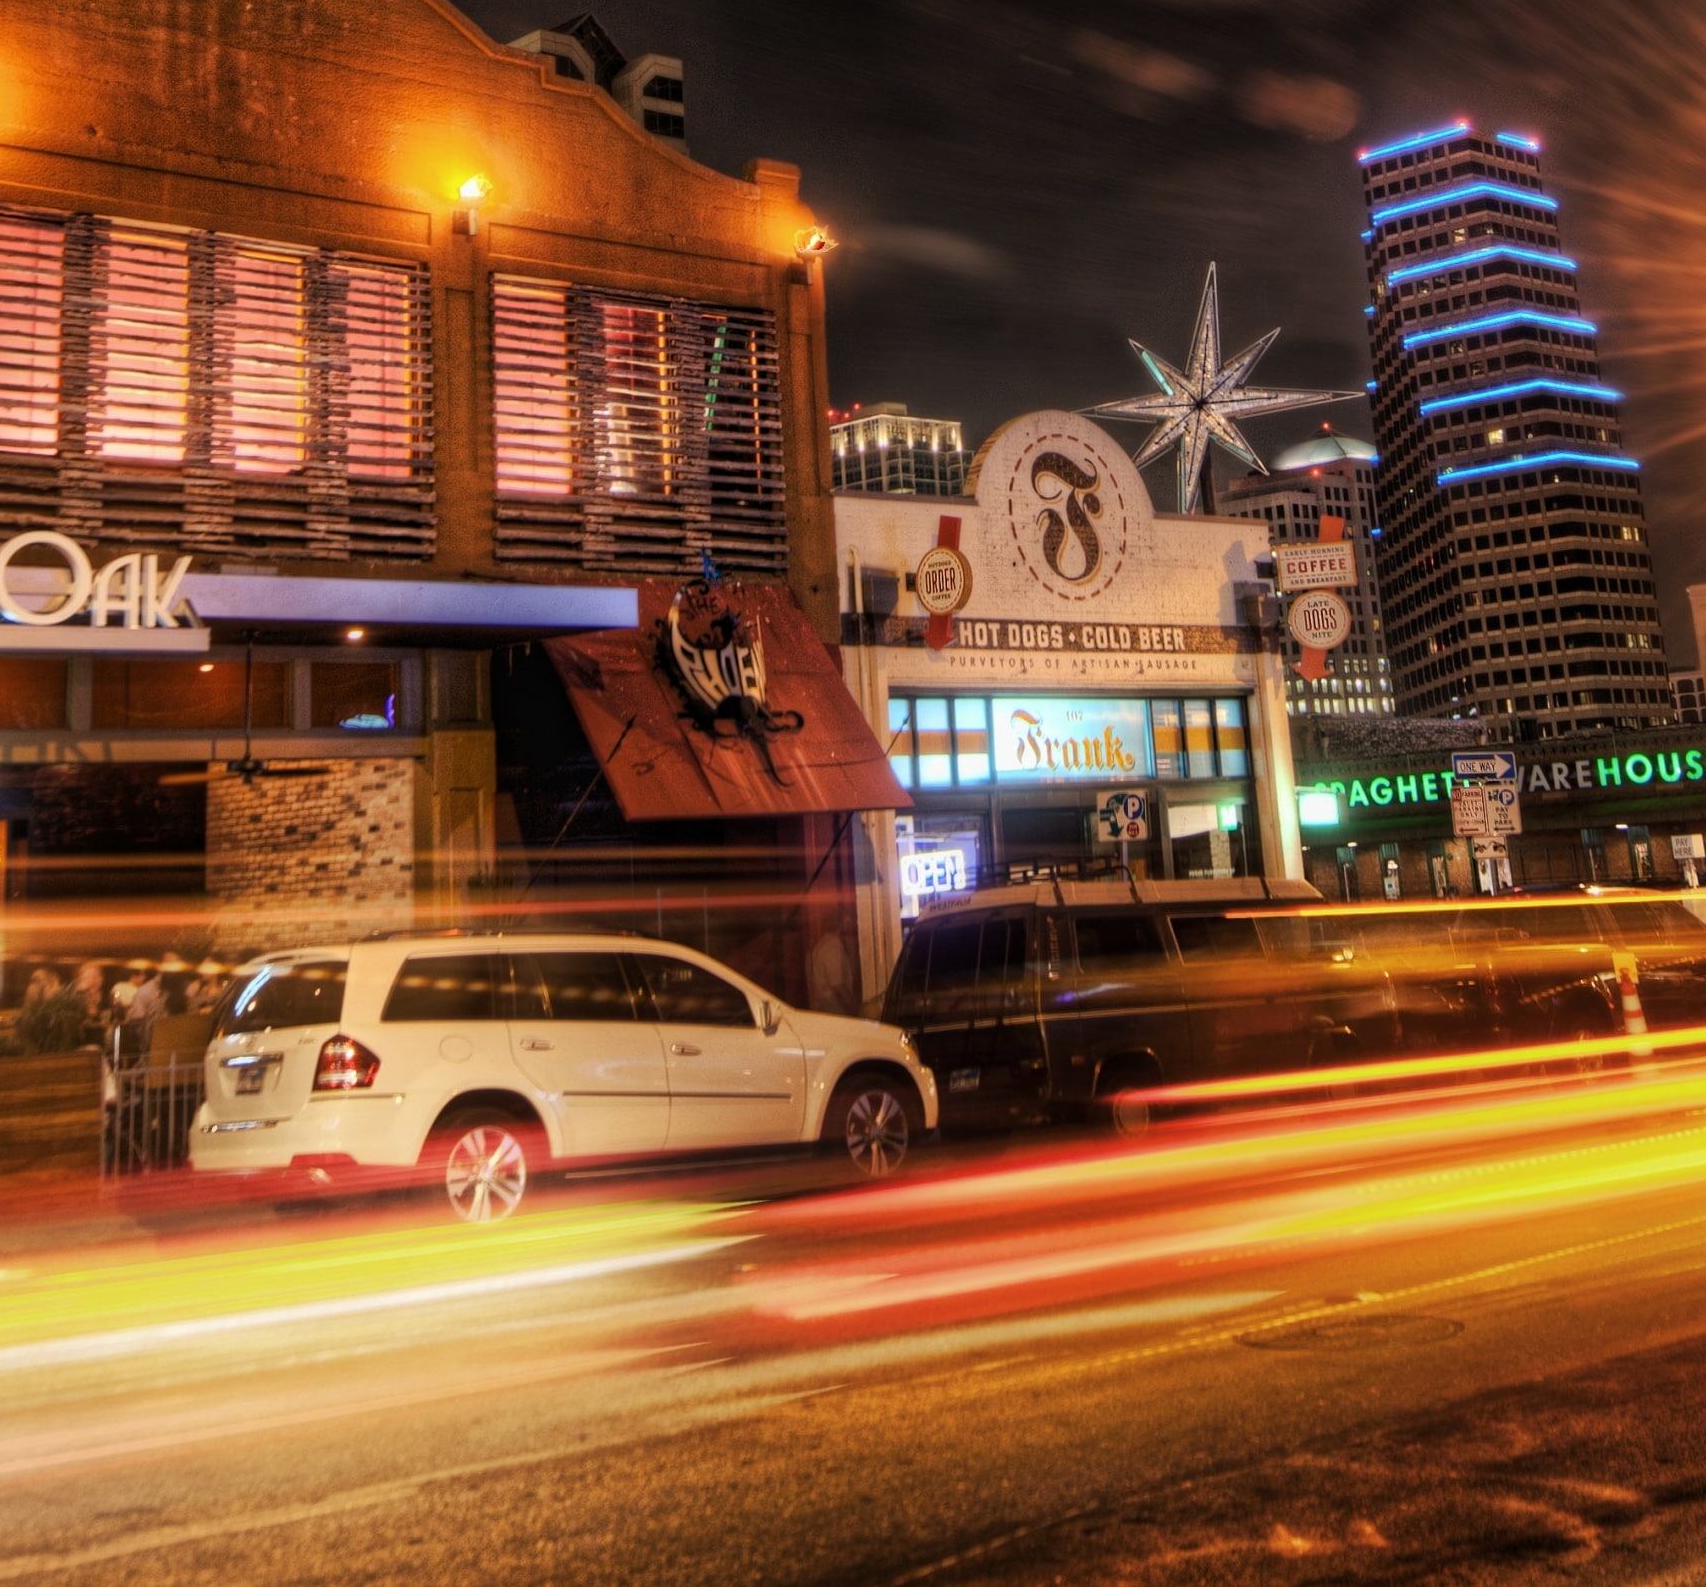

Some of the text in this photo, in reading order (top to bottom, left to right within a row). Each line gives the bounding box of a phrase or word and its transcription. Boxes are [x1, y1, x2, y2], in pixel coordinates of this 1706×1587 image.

[1284, 546, 1345, 557] EARLY MORNING
[1286, 558, 1347, 574] COFFEE
[925, 567, 956, 594] ORDER
[1307, 575, 1347, 584] BREAKFAST
[1307, 600, 1330, 608] LATE
[1303, 607, 1338, 632] DOGS
[958, 621, 1186, 651] HOT DOGS COLD BEER
[1311, 631, 1333, 639] NITE
[950, 656, 1197, 671] PURVEYORS OF ARTISAN SAUSAGE
[1066, 710, 1084, 722] 107
[1011, 709, 1136, 772] Frank
[1459, 762, 1496, 773] ONE WAY
[1127, 796, 1140, 818] P
[1675, 838, 1688, 847] PAY
[1674, 847, 1693, 857] HERE
[901, 851, 967, 895] OPEN
